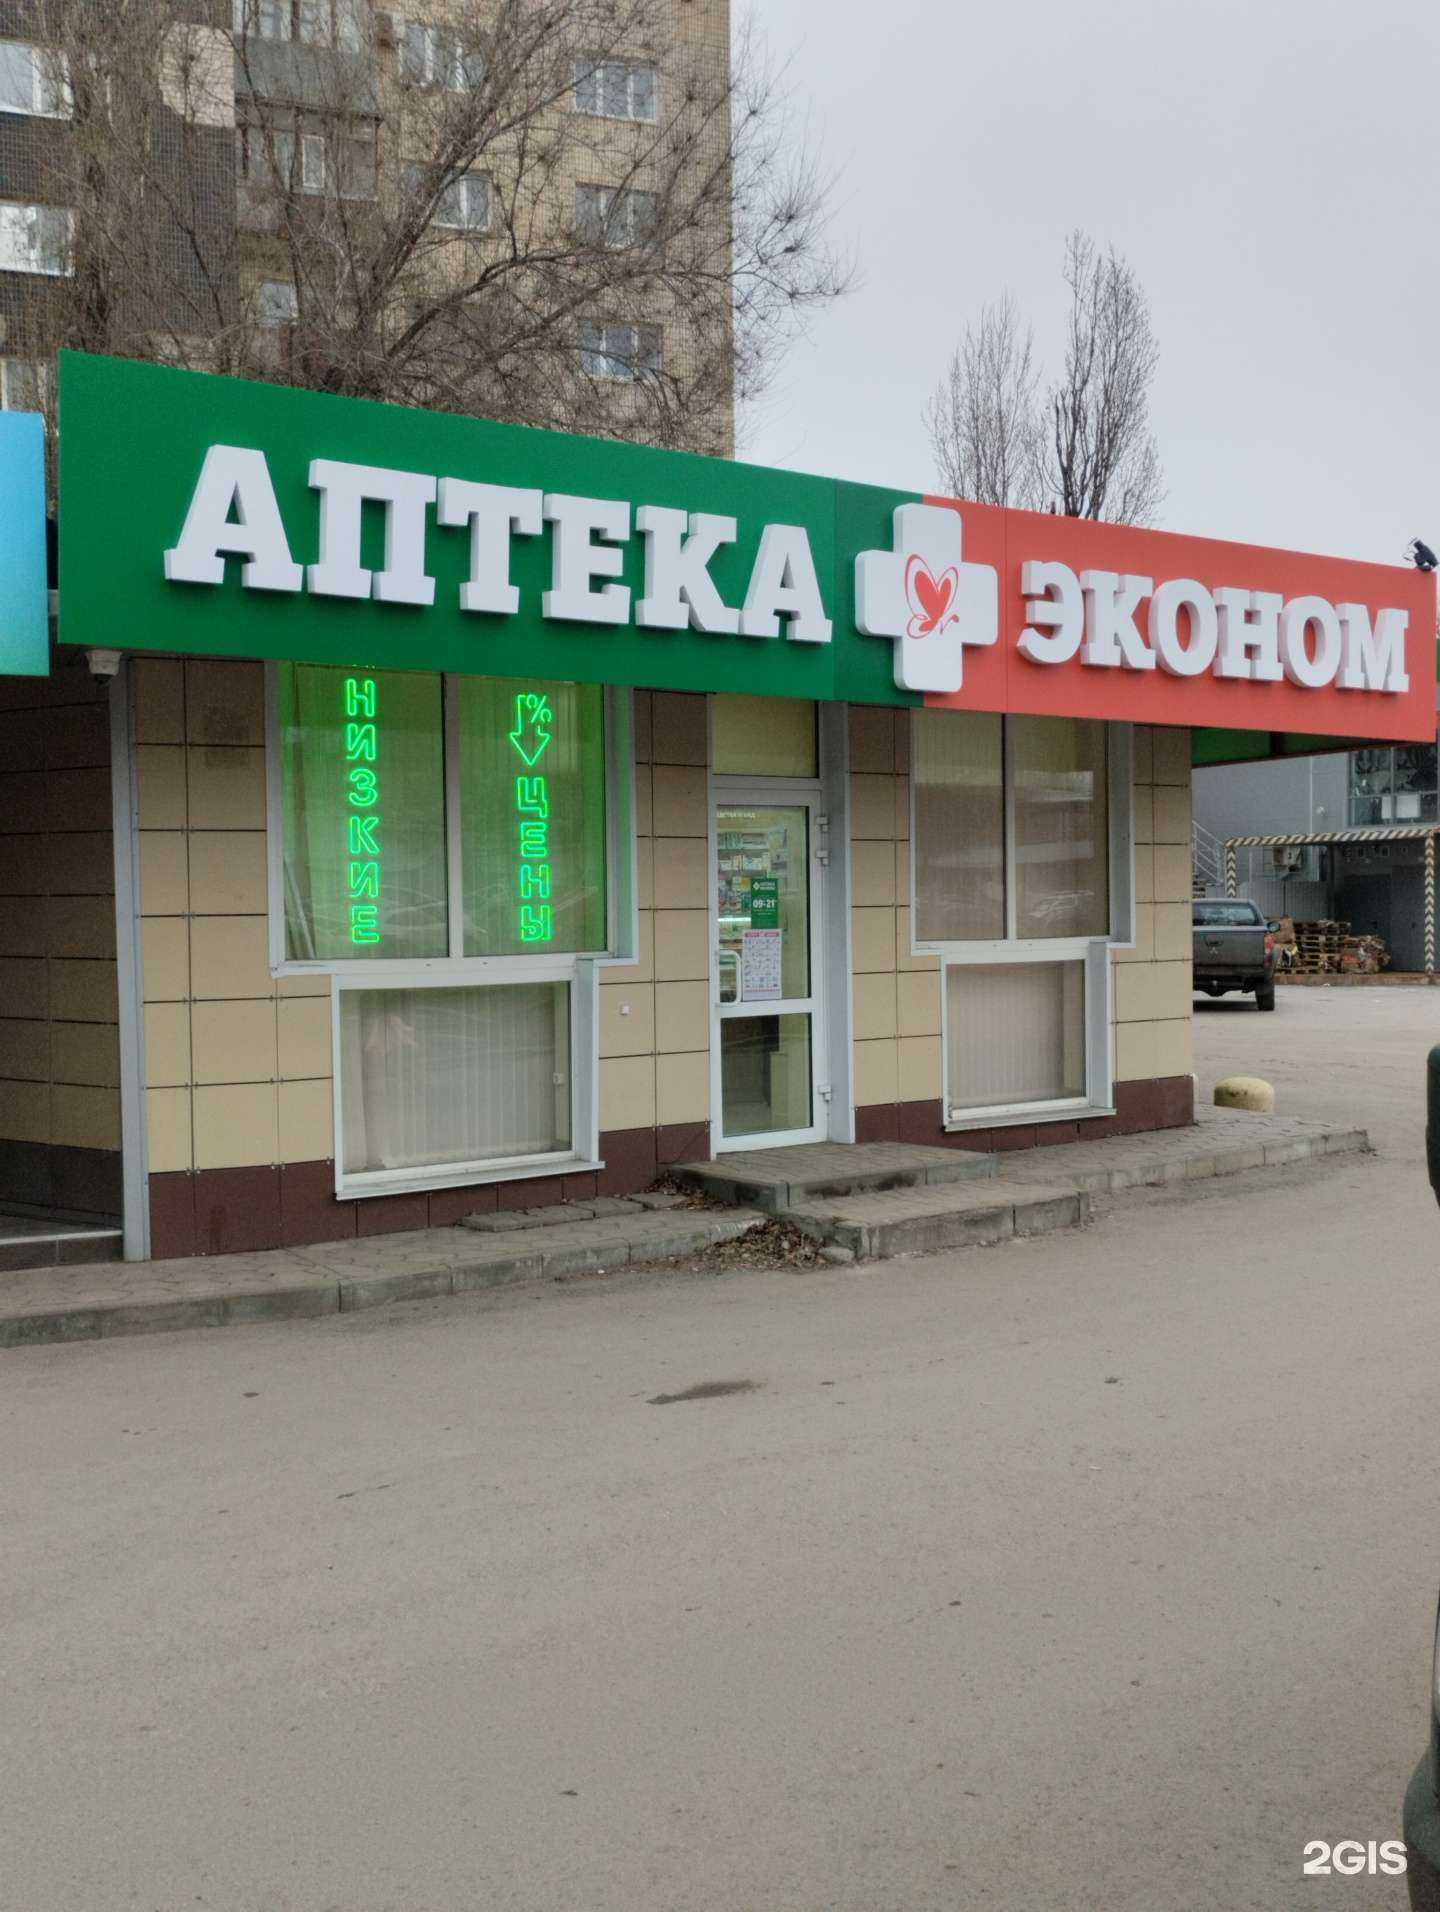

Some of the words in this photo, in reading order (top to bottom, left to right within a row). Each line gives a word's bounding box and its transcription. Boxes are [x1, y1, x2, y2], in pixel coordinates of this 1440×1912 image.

[164, 444, 832, 643] АПТЕКА
[1016, 560, 1409, 693] ЭКОНОМ
[345, 678, 380, 944] НИЗКИЕ
[517, 776, 552, 942] ЦЕНЫ
